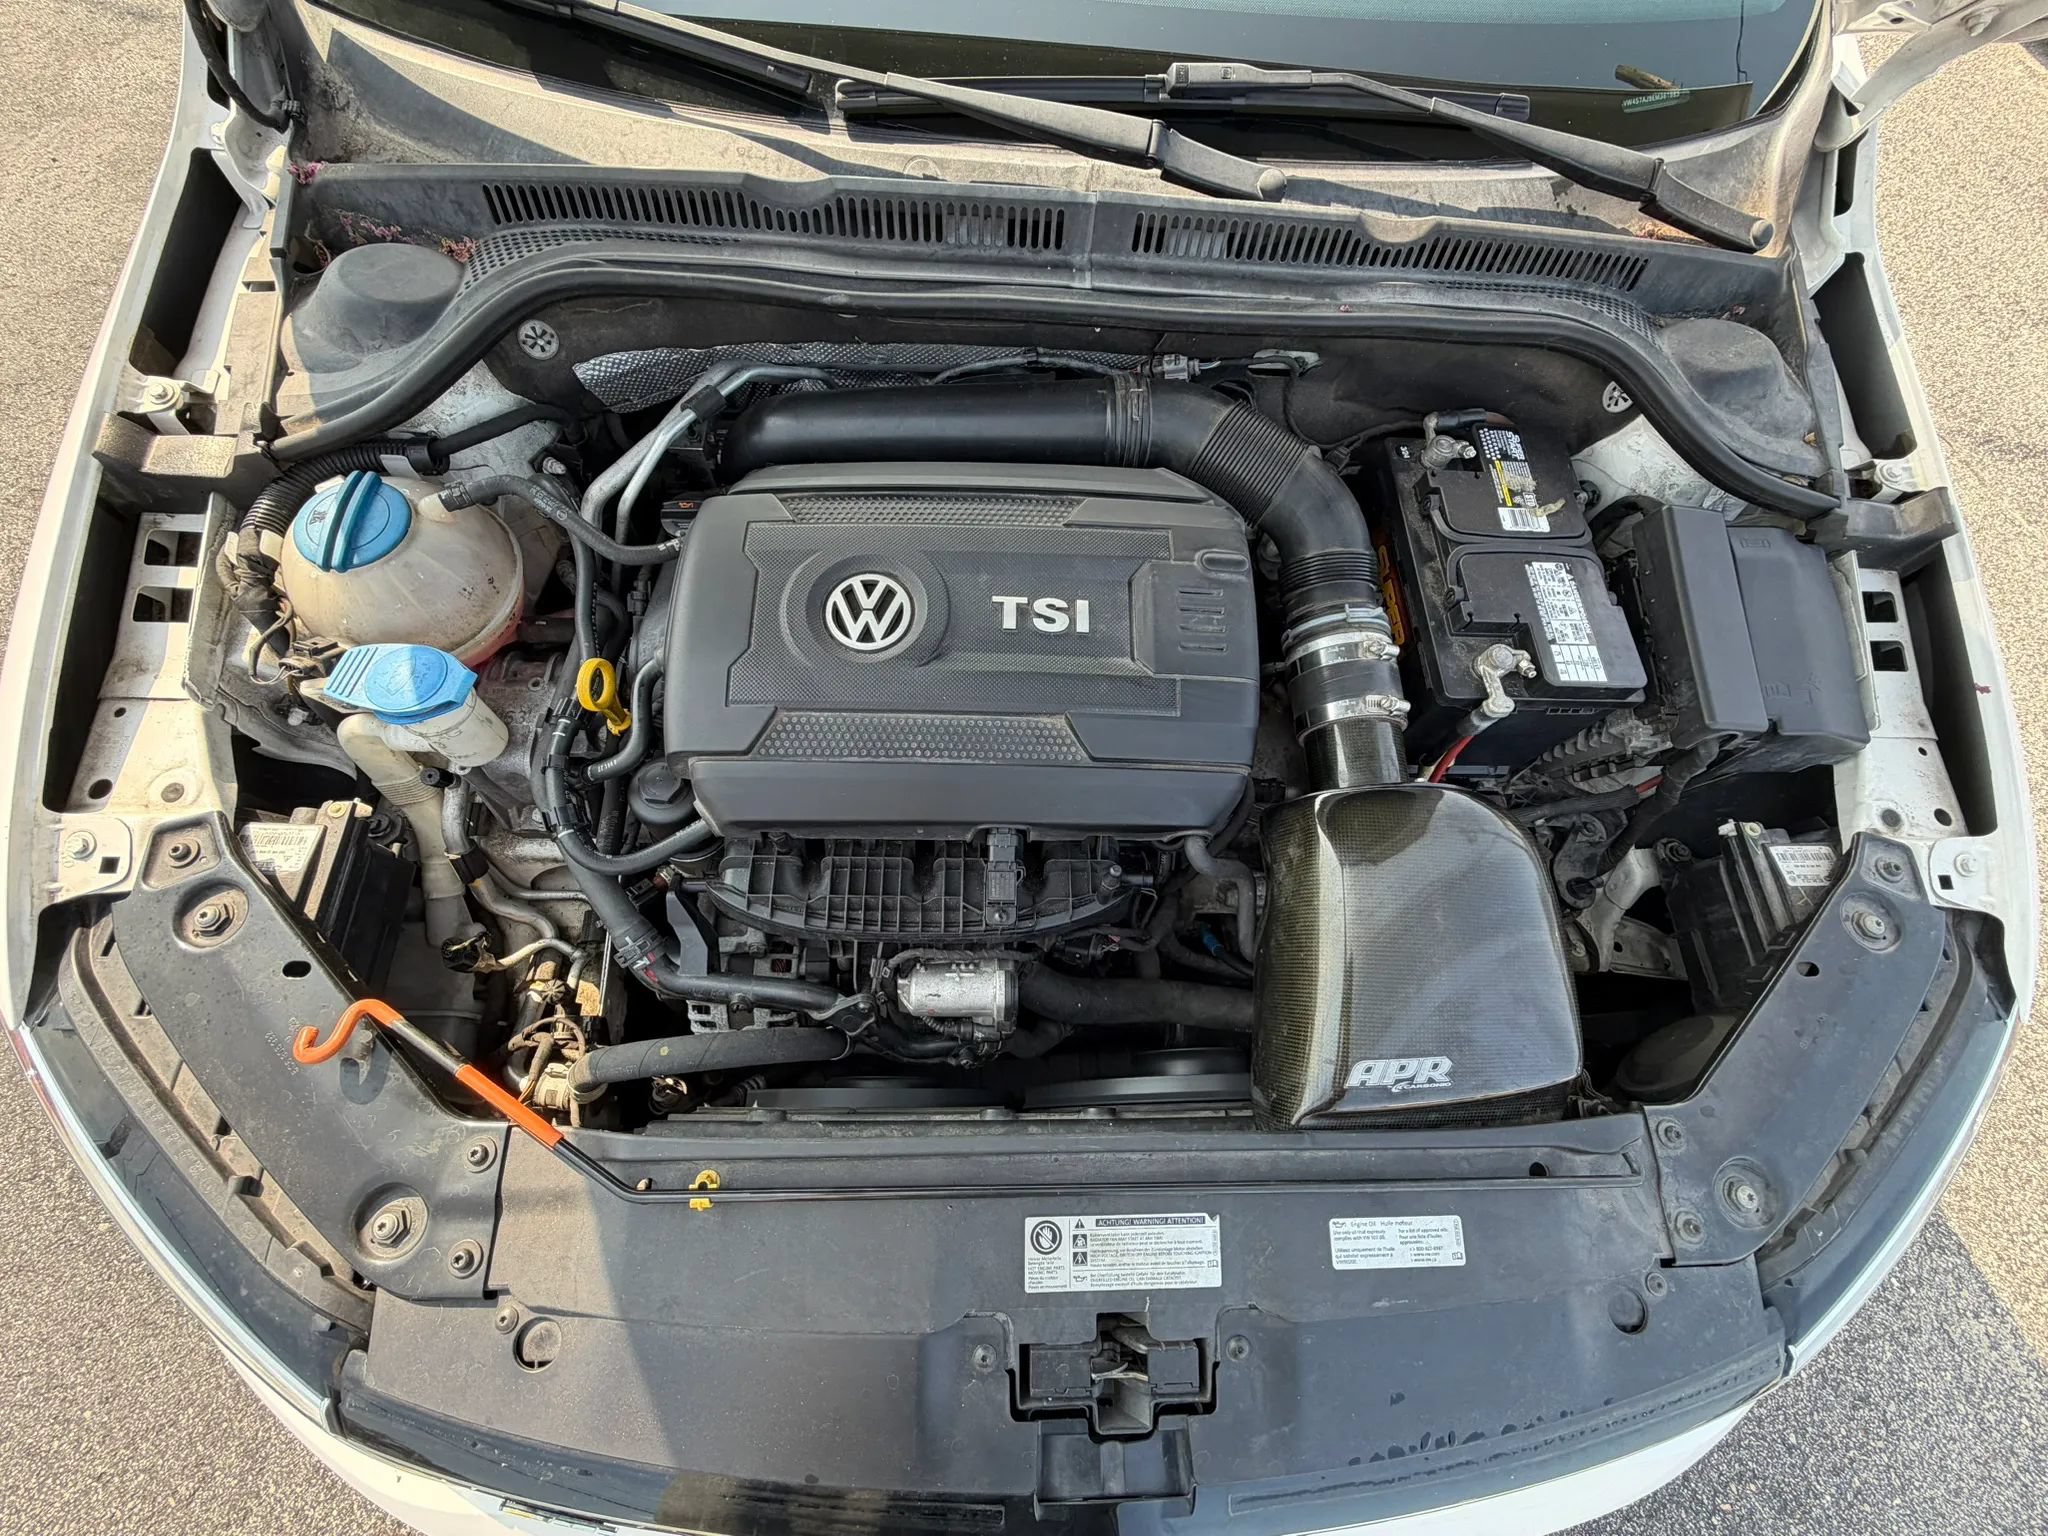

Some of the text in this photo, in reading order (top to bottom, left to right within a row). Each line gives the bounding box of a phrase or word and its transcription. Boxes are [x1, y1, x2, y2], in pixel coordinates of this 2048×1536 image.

[1506, 430, 1518, 459] START
[1513, 434, 1526, 460] SUPER
[992, 594, 1090, 634] TSI
[1344, 1056, 1453, 1088] APR
